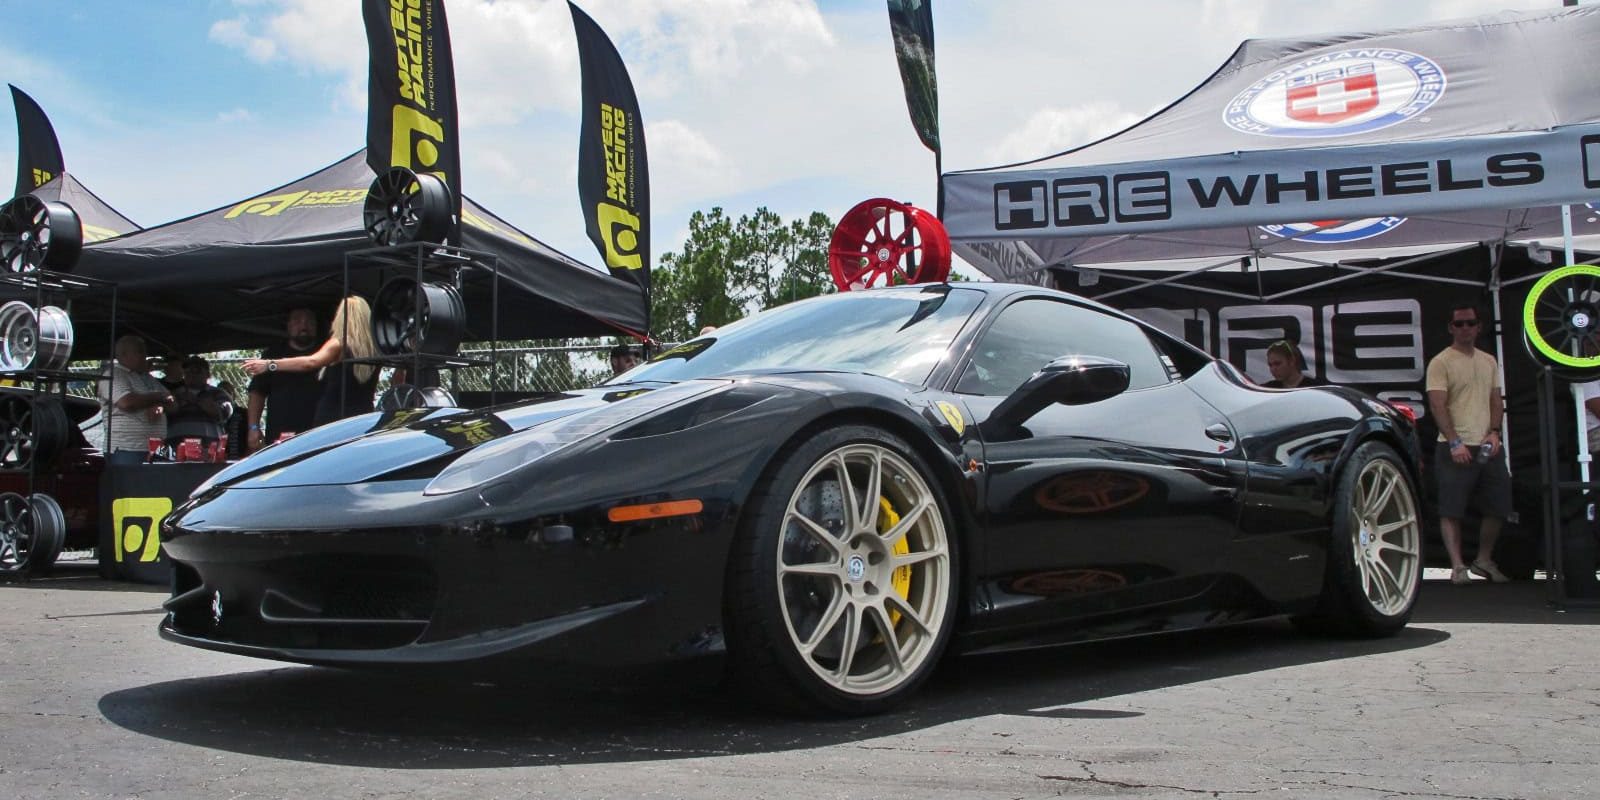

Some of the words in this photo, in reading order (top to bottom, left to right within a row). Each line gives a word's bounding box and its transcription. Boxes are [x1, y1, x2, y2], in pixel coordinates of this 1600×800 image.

[427, 35, 435, 111] PERFORMANCE
[1395, 60, 1441, 117] WHEELS
[601, 103, 618, 200] MOTEGI
[614, 107, 627, 205] RACING
[994, 170, 1172, 231] HRE
[1187, 151, 1545, 209] WHEELS
